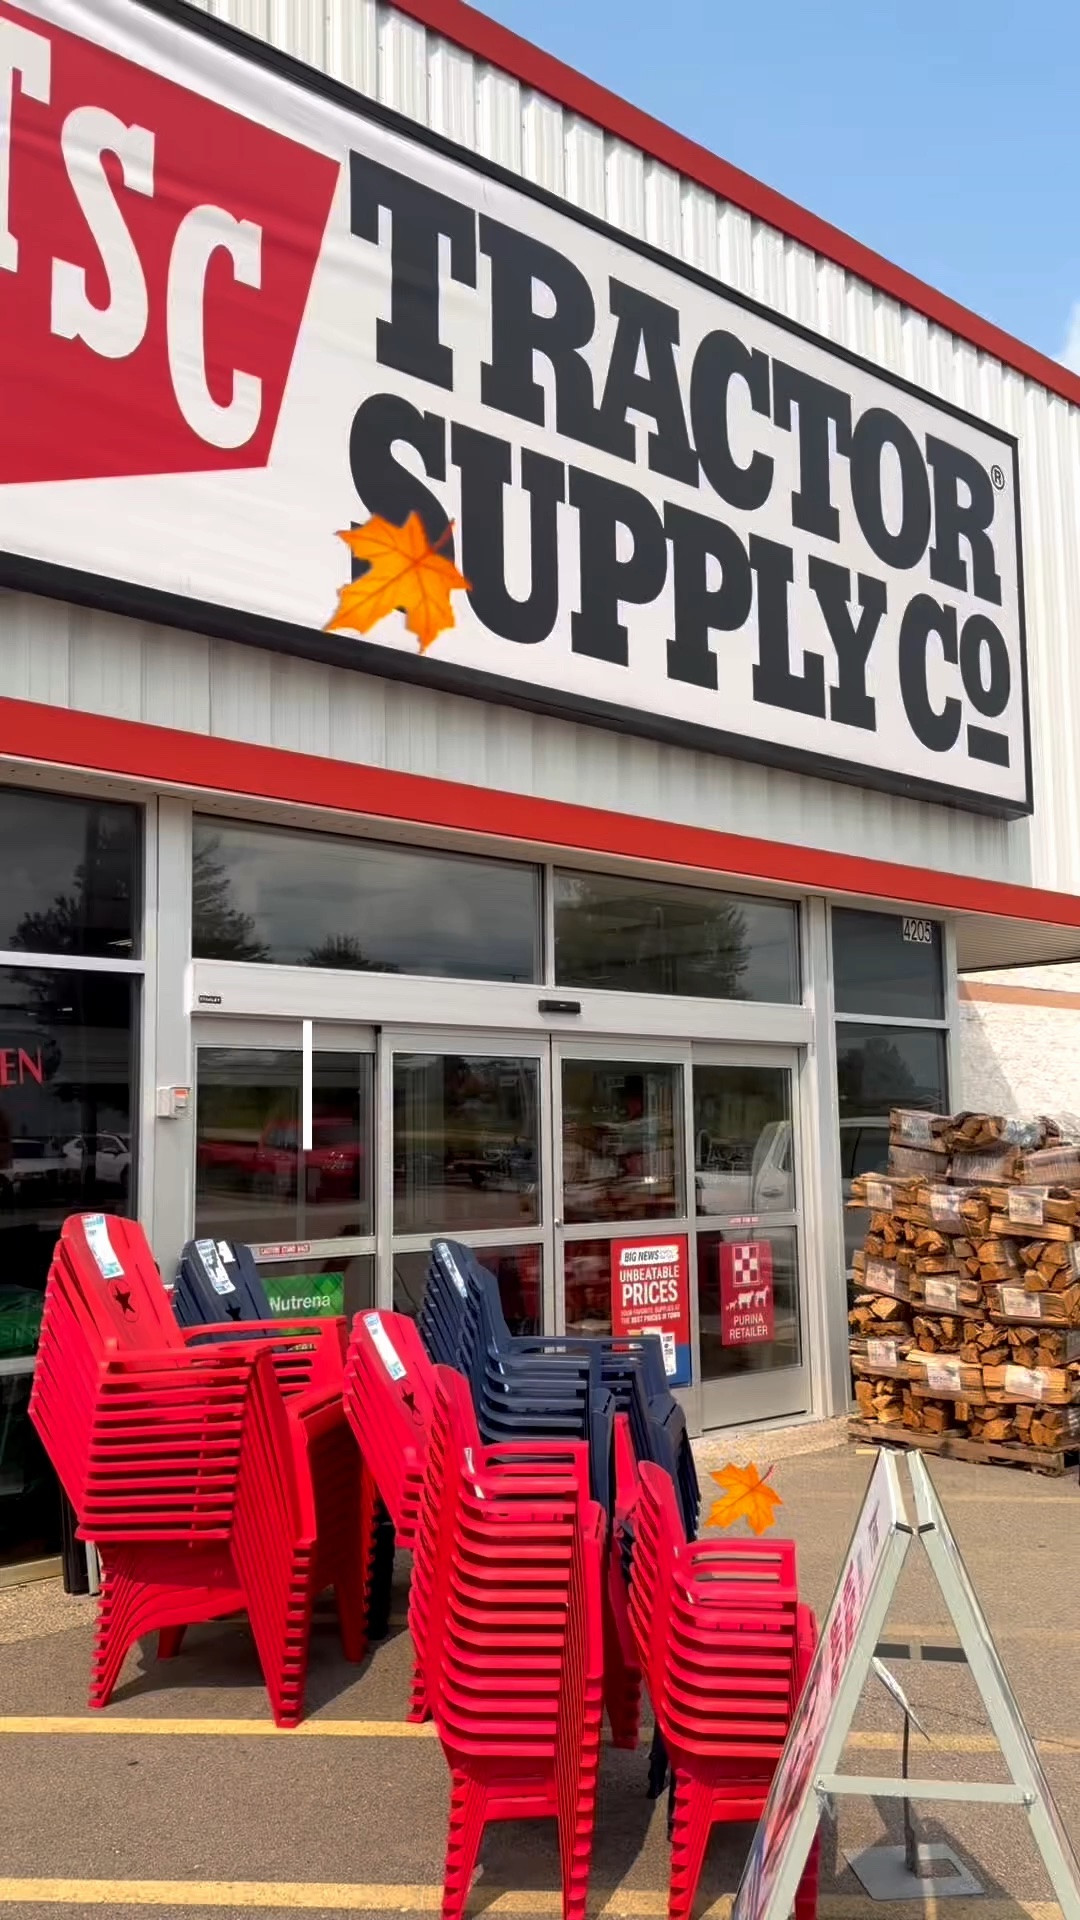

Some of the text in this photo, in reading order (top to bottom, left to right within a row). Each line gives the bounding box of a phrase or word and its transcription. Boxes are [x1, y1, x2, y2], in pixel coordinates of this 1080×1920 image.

[349, 148, 1001, 606] TRACTOR
[349, 392, 888, 732] SUPPLY
[904, 919, 931, 942] 4205
[624, 1250, 637, 1262] BIG
[638, 1249, 660, 1261] NEWS
[620, 1265, 680, 1282] UNBEATABLE
[622, 1279, 678, 1307] PRICES
[269, 1295, 331, 1312] Nutrena
[733, 1312, 764, 1327] PURINA
[729, 1325, 768, 1340] RETAILER
